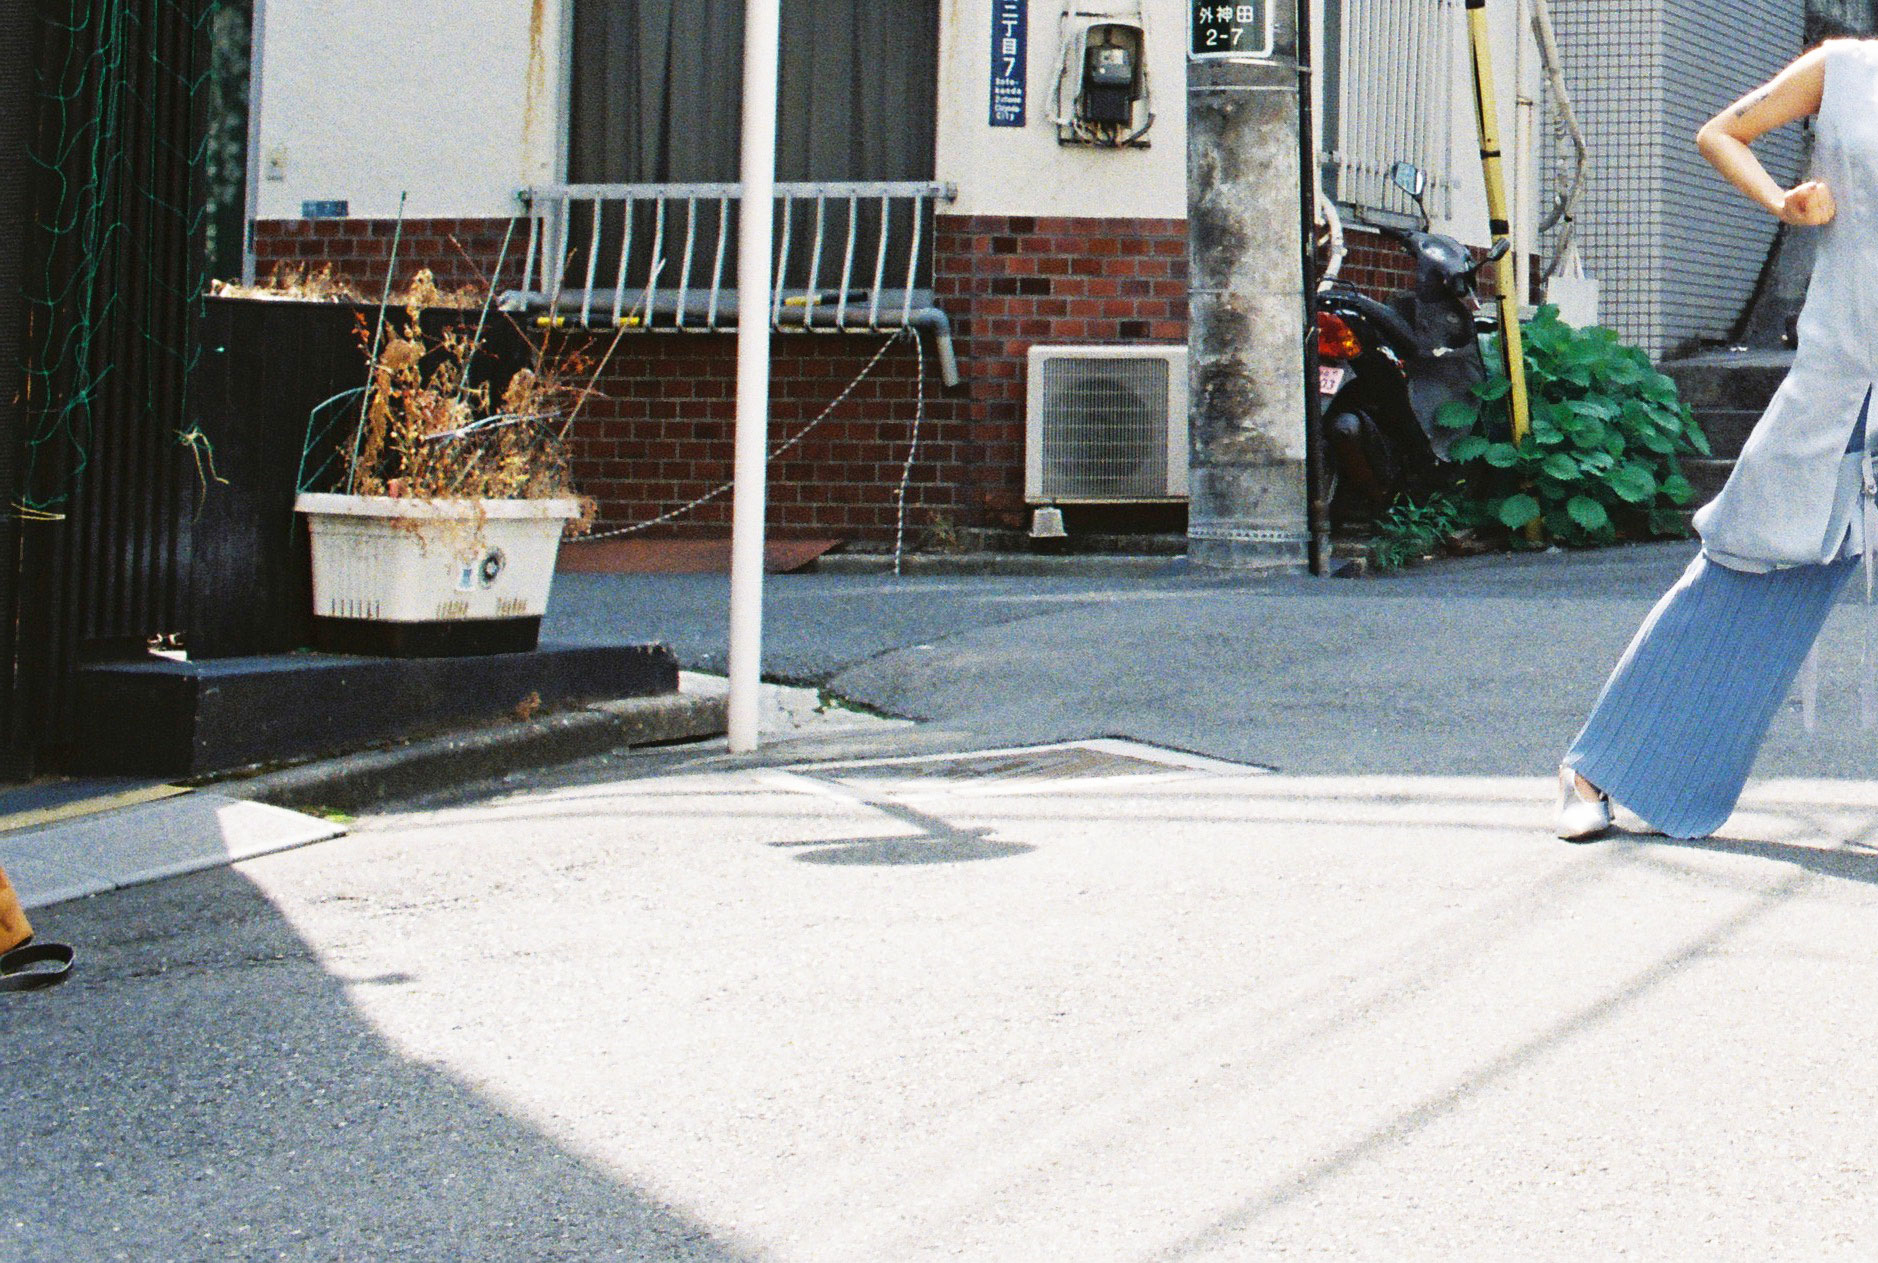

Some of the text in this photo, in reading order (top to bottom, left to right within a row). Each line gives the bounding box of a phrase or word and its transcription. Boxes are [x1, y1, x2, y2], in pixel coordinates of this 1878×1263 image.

[1199, 5, 1254, 24] 外神田
[1206, 28, 1244, 46] 2-7
